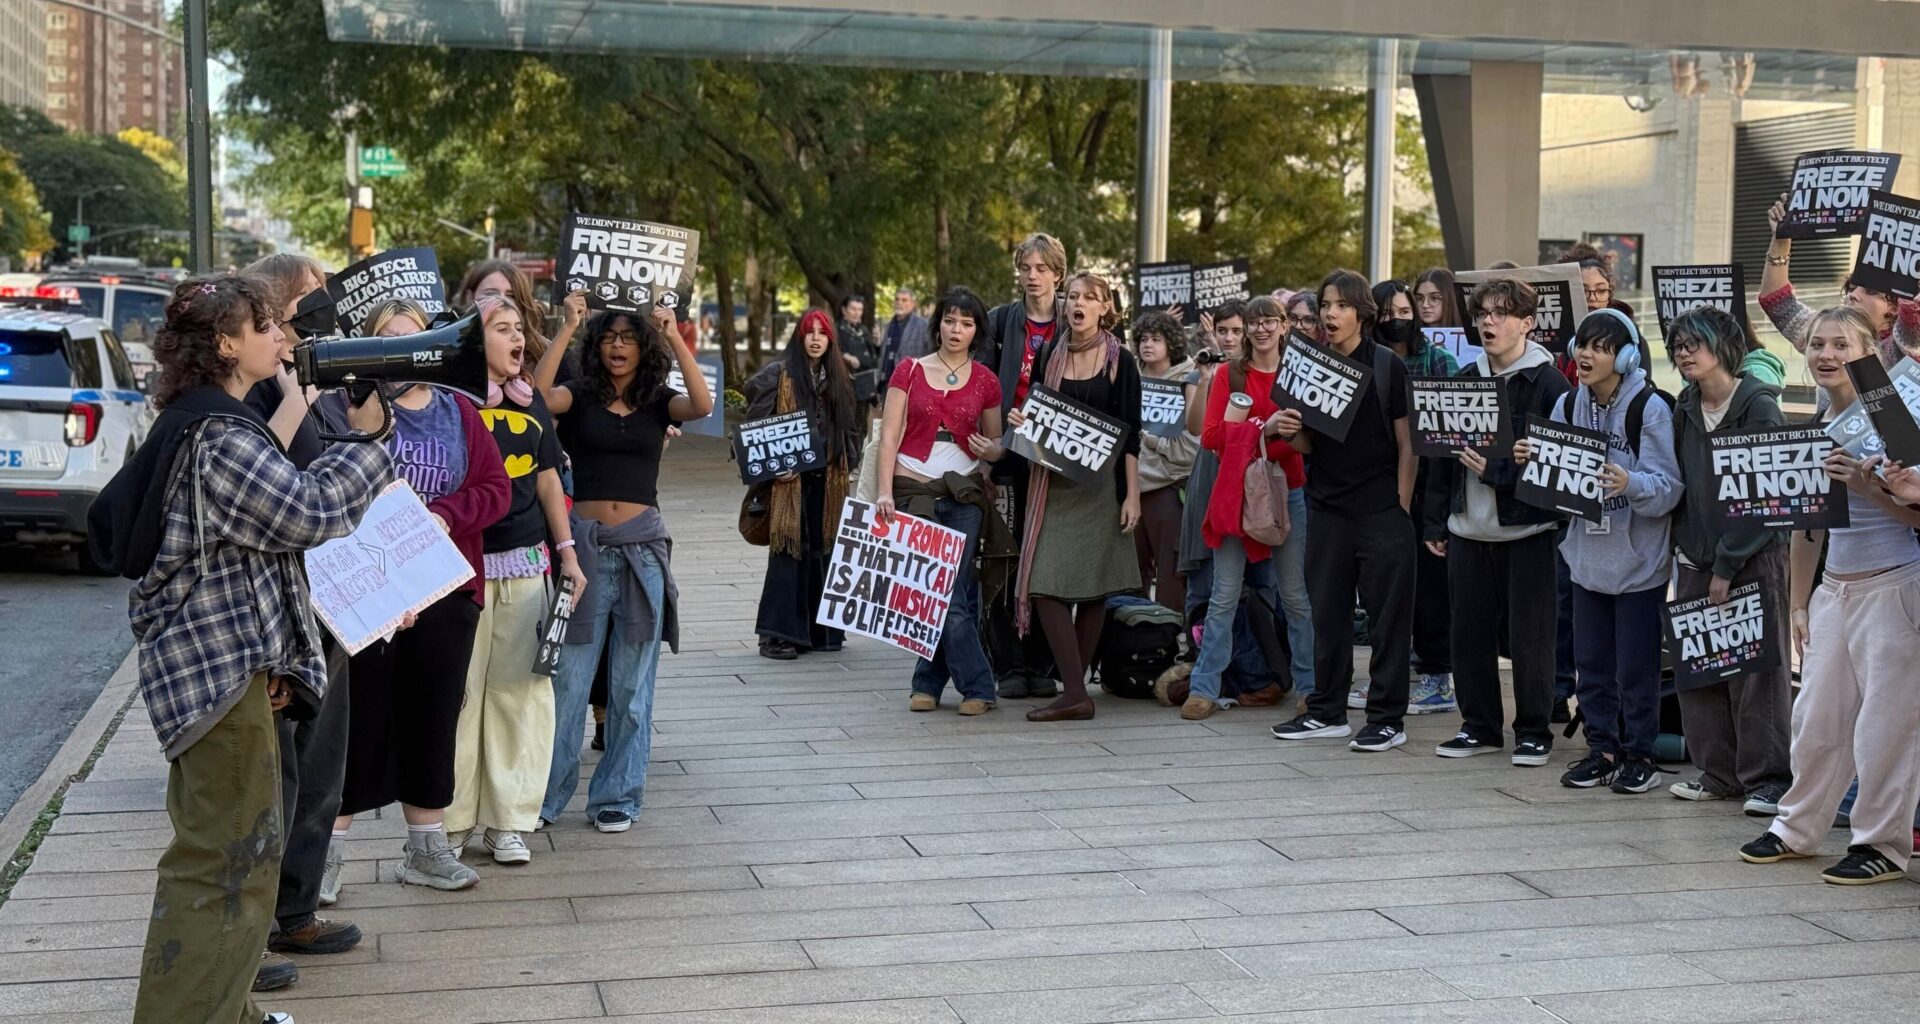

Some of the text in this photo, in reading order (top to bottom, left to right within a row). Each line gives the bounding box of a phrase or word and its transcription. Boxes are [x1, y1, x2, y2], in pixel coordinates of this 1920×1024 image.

[1866, 156, 1890, 165] TECH
[1792, 165, 1887, 191] FREEZE
[1788, 189, 1812, 211] AI
[1873, 200, 1885, 209] WE
[576, 216, 591, 226] WE
[621, 222, 651, 233] ELECT
[650, 226, 666, 237] BIG
[665, 229, 688, 240] TECH
[1866, 213, 1920, 251] FREE
[571, 228, 687, 266] FREEZE
[1862, 240, 1920, 280] AI NO
[342, 257, 418, 294] BIG TECH
[569, 253, 602, 278] AI
[608, 257, 682, 289] NOW
[1140, 273, 1192, 292] FREEZE
[1195, 272, 1248, 290] IONAIRES
[1202, 265, 1234, 279] TECH
[1699, 267, 1712, 275] BIG
[336, 271, 437, 317] BILLIONAIRES
[393, 285, 433, 300] OWN
[1141, 288, 1191, 307] AI NOW
[1213, 284, 1242, 297] OWN
[1657, 277, 1734, 298] FREEZE
[1662, 299, 1675, 319] AI
[412, 350, 443, 362] PYLE
[1310, 349, 1331, 363] ELECT
[1329, 358, 1342, 370] BIG
[1341, 365, 1363, 379] TECH
[1281, 344, 1358, 403] FREEZE
[1412, 381, 1422, 389] WE
[1443, 381, 1465, 389] ELECT
[1465, 381, 1477, 389] BIG
[1478, 381, 1497, 389] TECH
[1141, 390, 1186, 411] EEZE
[1276, 366, 1349, 419] AI NOW
[1413, 390, 1500, 412] FREEZE
[1032, 389, 1044, 401] WE
[1065, 405, 1090, 421] ELECT
[1088, 416, 1103, 428] BIG
[1101, 421, 1122, 436] TECH
[1141, 406, 1182, 425] NOW
[1417, 411, 1499, 433] AI NOW
[741, 418, 810, 447] FREEZE
[1021, 399, 1117, 457] FREEZE
[1529, 423, 1542, 433] WE
[1572, 435, 1601, 449] ELECT
[1711, 437, 1728, 447] WE
[1758, 432, 1789, 443] ELECT
[1788, 430, 1806, 440] BIG
[386, 430, 448, 468] Death
[748, 433, 811, 462] AI NOW
[1014, 420, 1108, 472] AI NOW
[1527, 436, 1605, 477] FREE
[1712, 441, 1834, 475] FREEZE
[1522, 460, 1551, 488] AI
[1718, 468, 1831, 501] AI NOW
[844, 500, 966, 566] I STRONGLY
[308, 543, 361, 587] HUMAN
[837, 536, 957, 598] THAT IT (AI)
[827, 563, 948, 629] IS AN INSULT
[1668, 605, 1682, 615] WE
[1740, 582, 1760, 595] TECH
[823, 593, 941, 647] TO LIFE ITSELF
[1671, 593, 1764, 640] FREEZE
[1681, 616, 1764, 661] AI NOW
